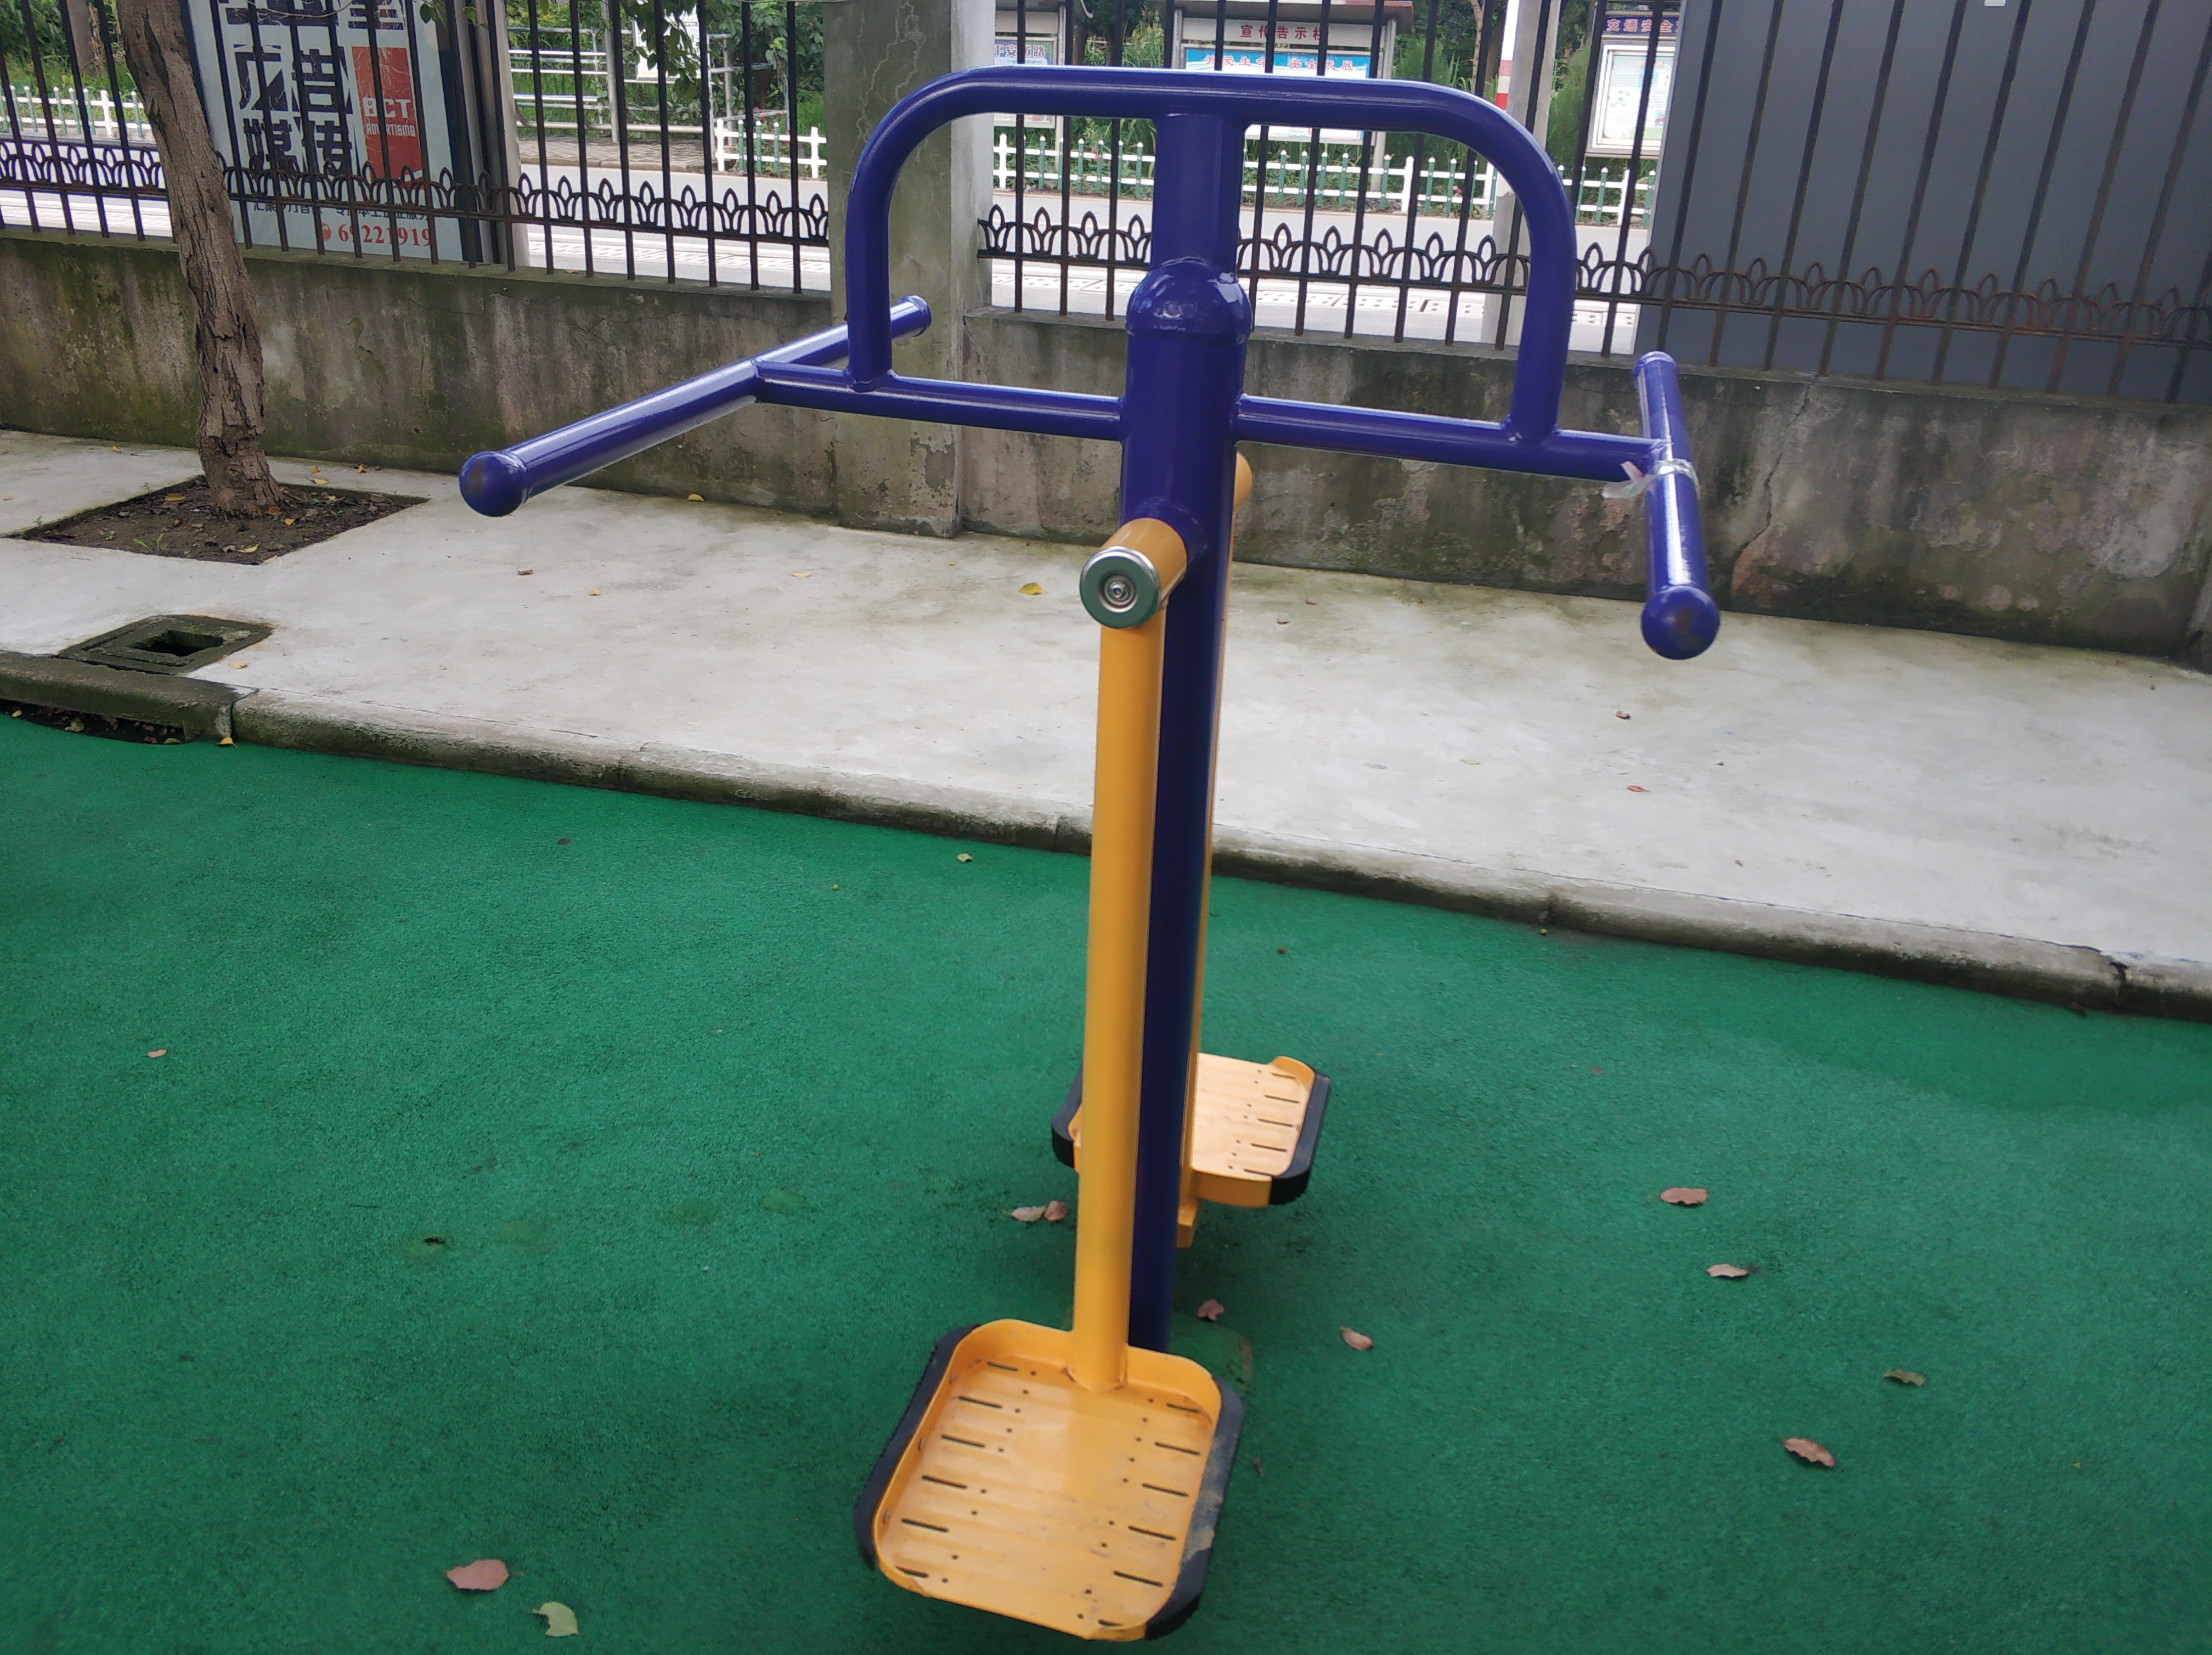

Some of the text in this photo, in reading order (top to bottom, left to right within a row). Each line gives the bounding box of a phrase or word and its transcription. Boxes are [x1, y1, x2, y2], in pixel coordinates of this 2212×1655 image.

[1606, 18, 1679, 32] 交通安全
[362, 97, 411, 119] BCT
[366, 122, 416, 137] ADVRTISING
